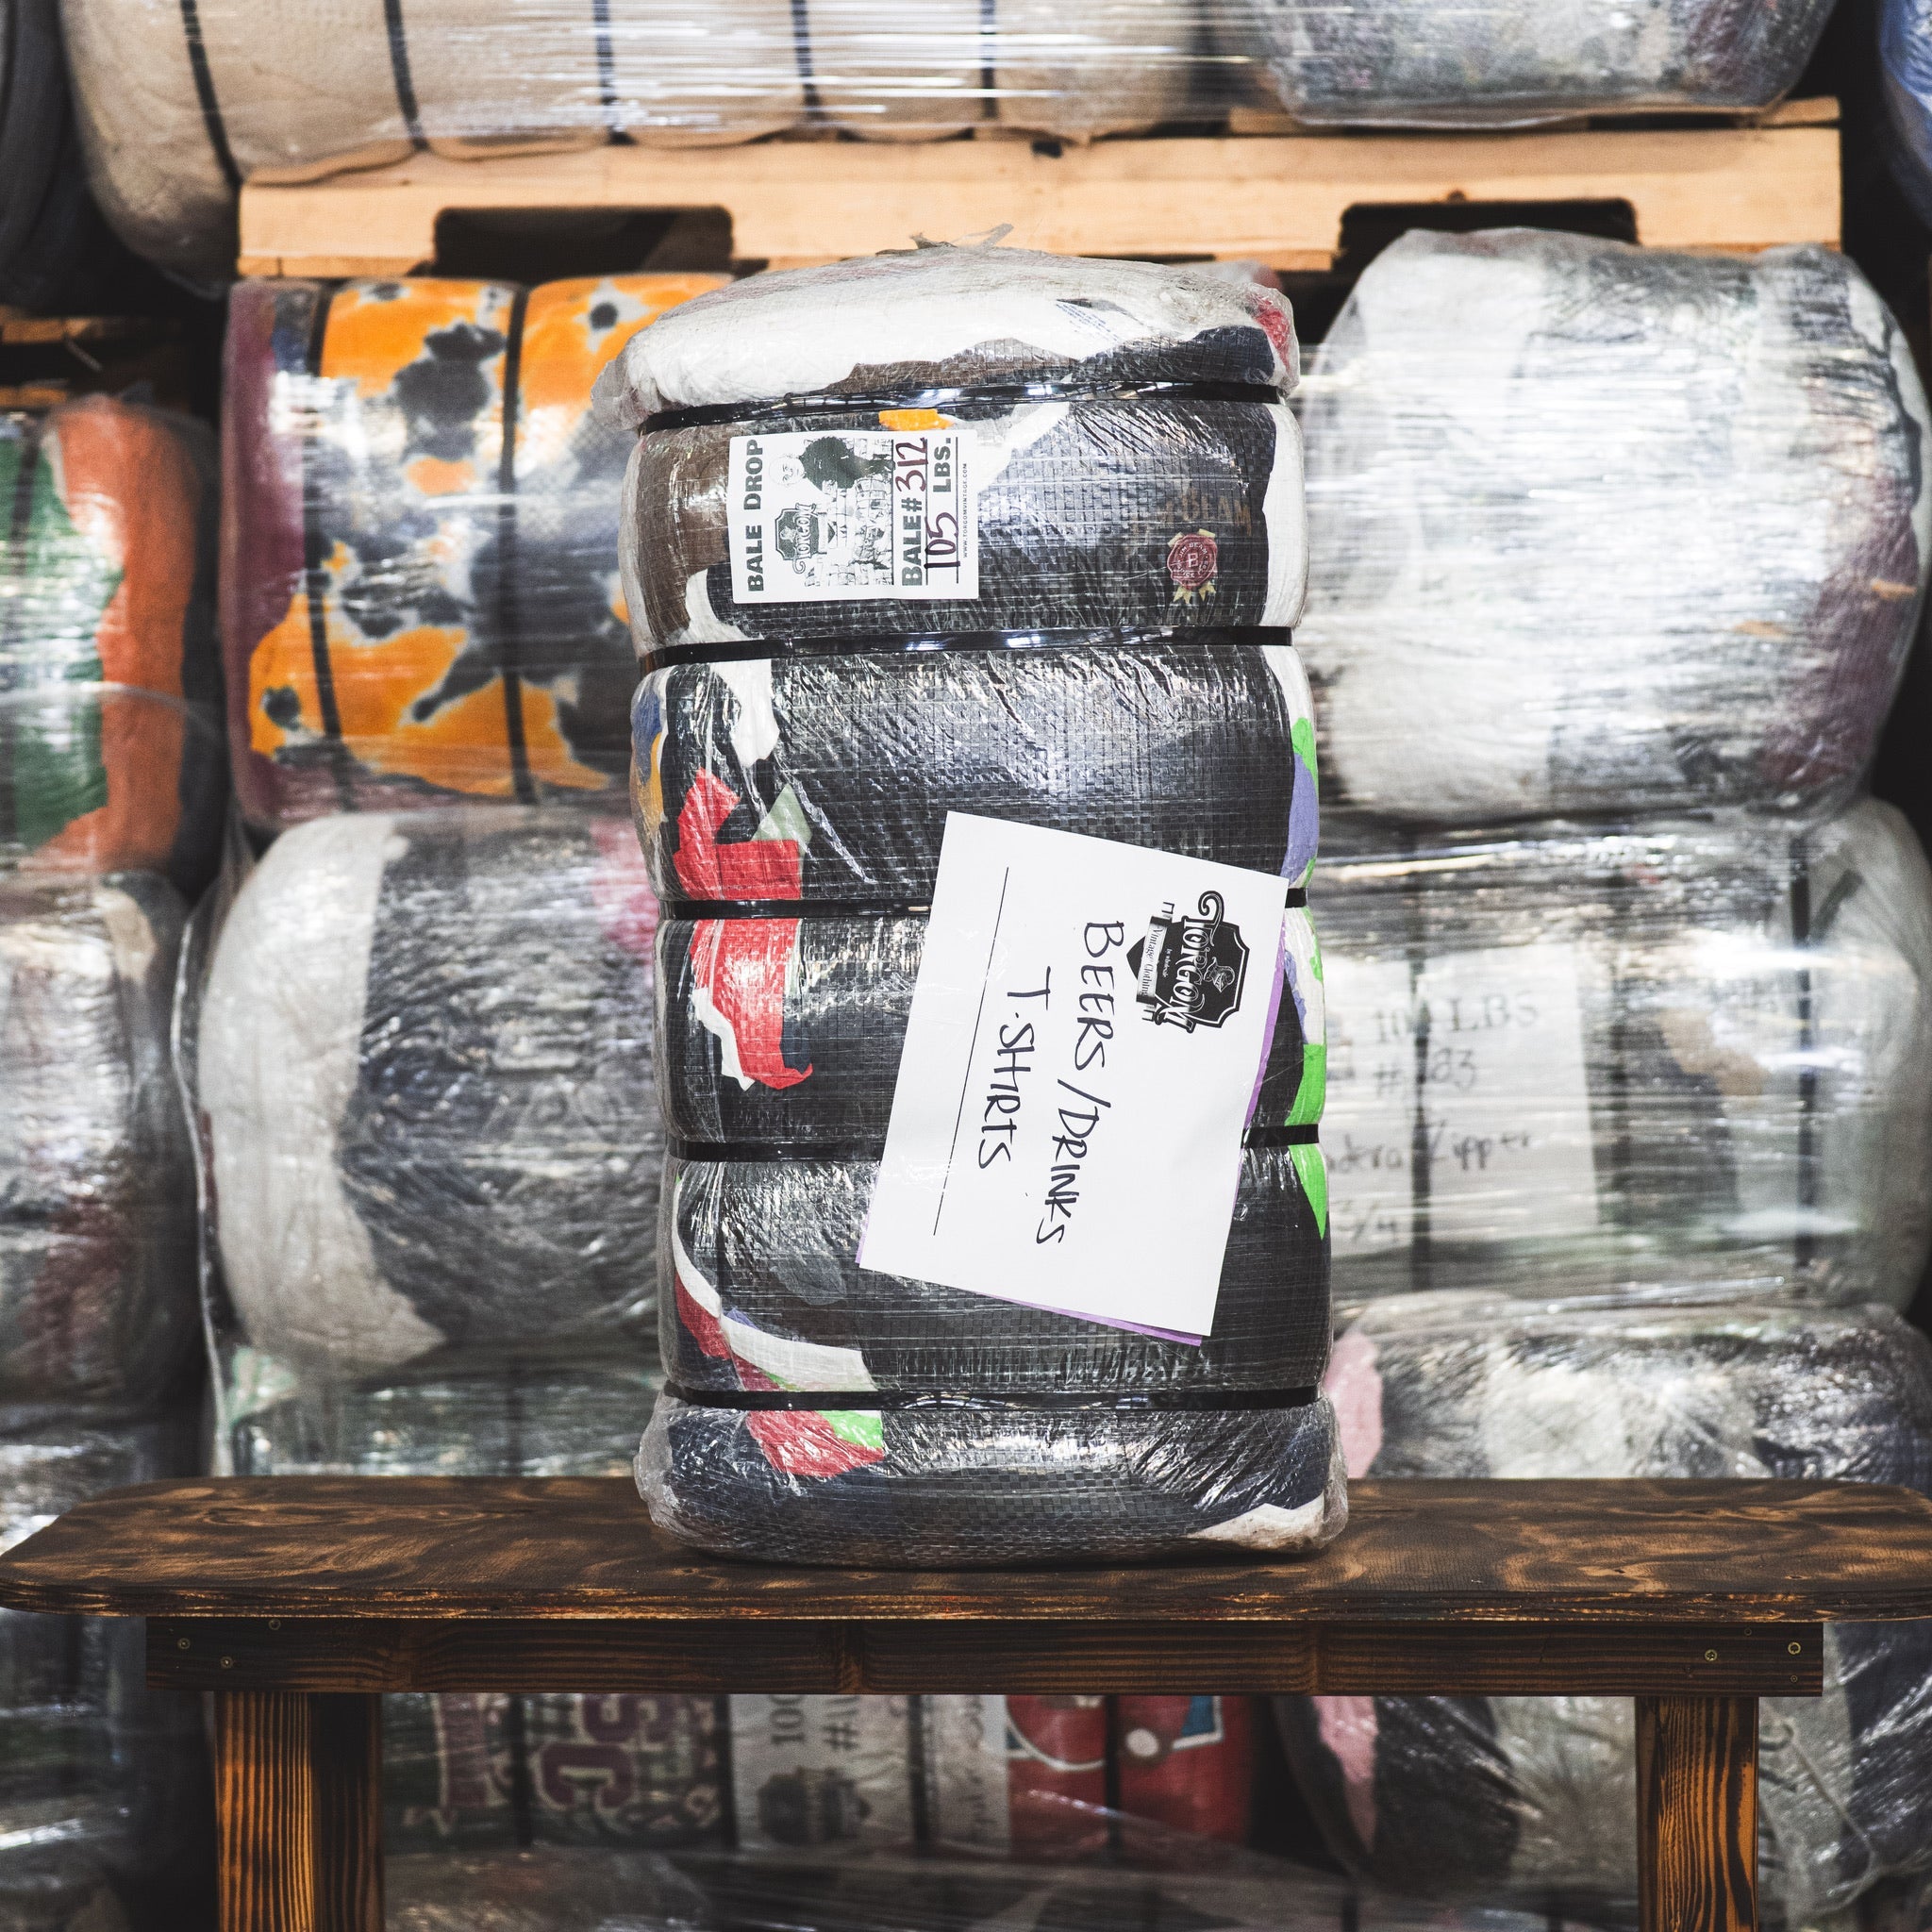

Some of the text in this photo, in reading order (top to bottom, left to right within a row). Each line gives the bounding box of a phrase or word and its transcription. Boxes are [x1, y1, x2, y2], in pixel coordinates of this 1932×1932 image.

[743, 439, 764, 591] BALE DROP
[895, 437, 929, 492] 312
[924, 437, 961, 570] 105 LBS.
[1139, 926, 1163, 997] Vintage Clothing
[1154, 891, 1224, 1034] TORGOM
[1446, 990, 1540, 1034] LBS
